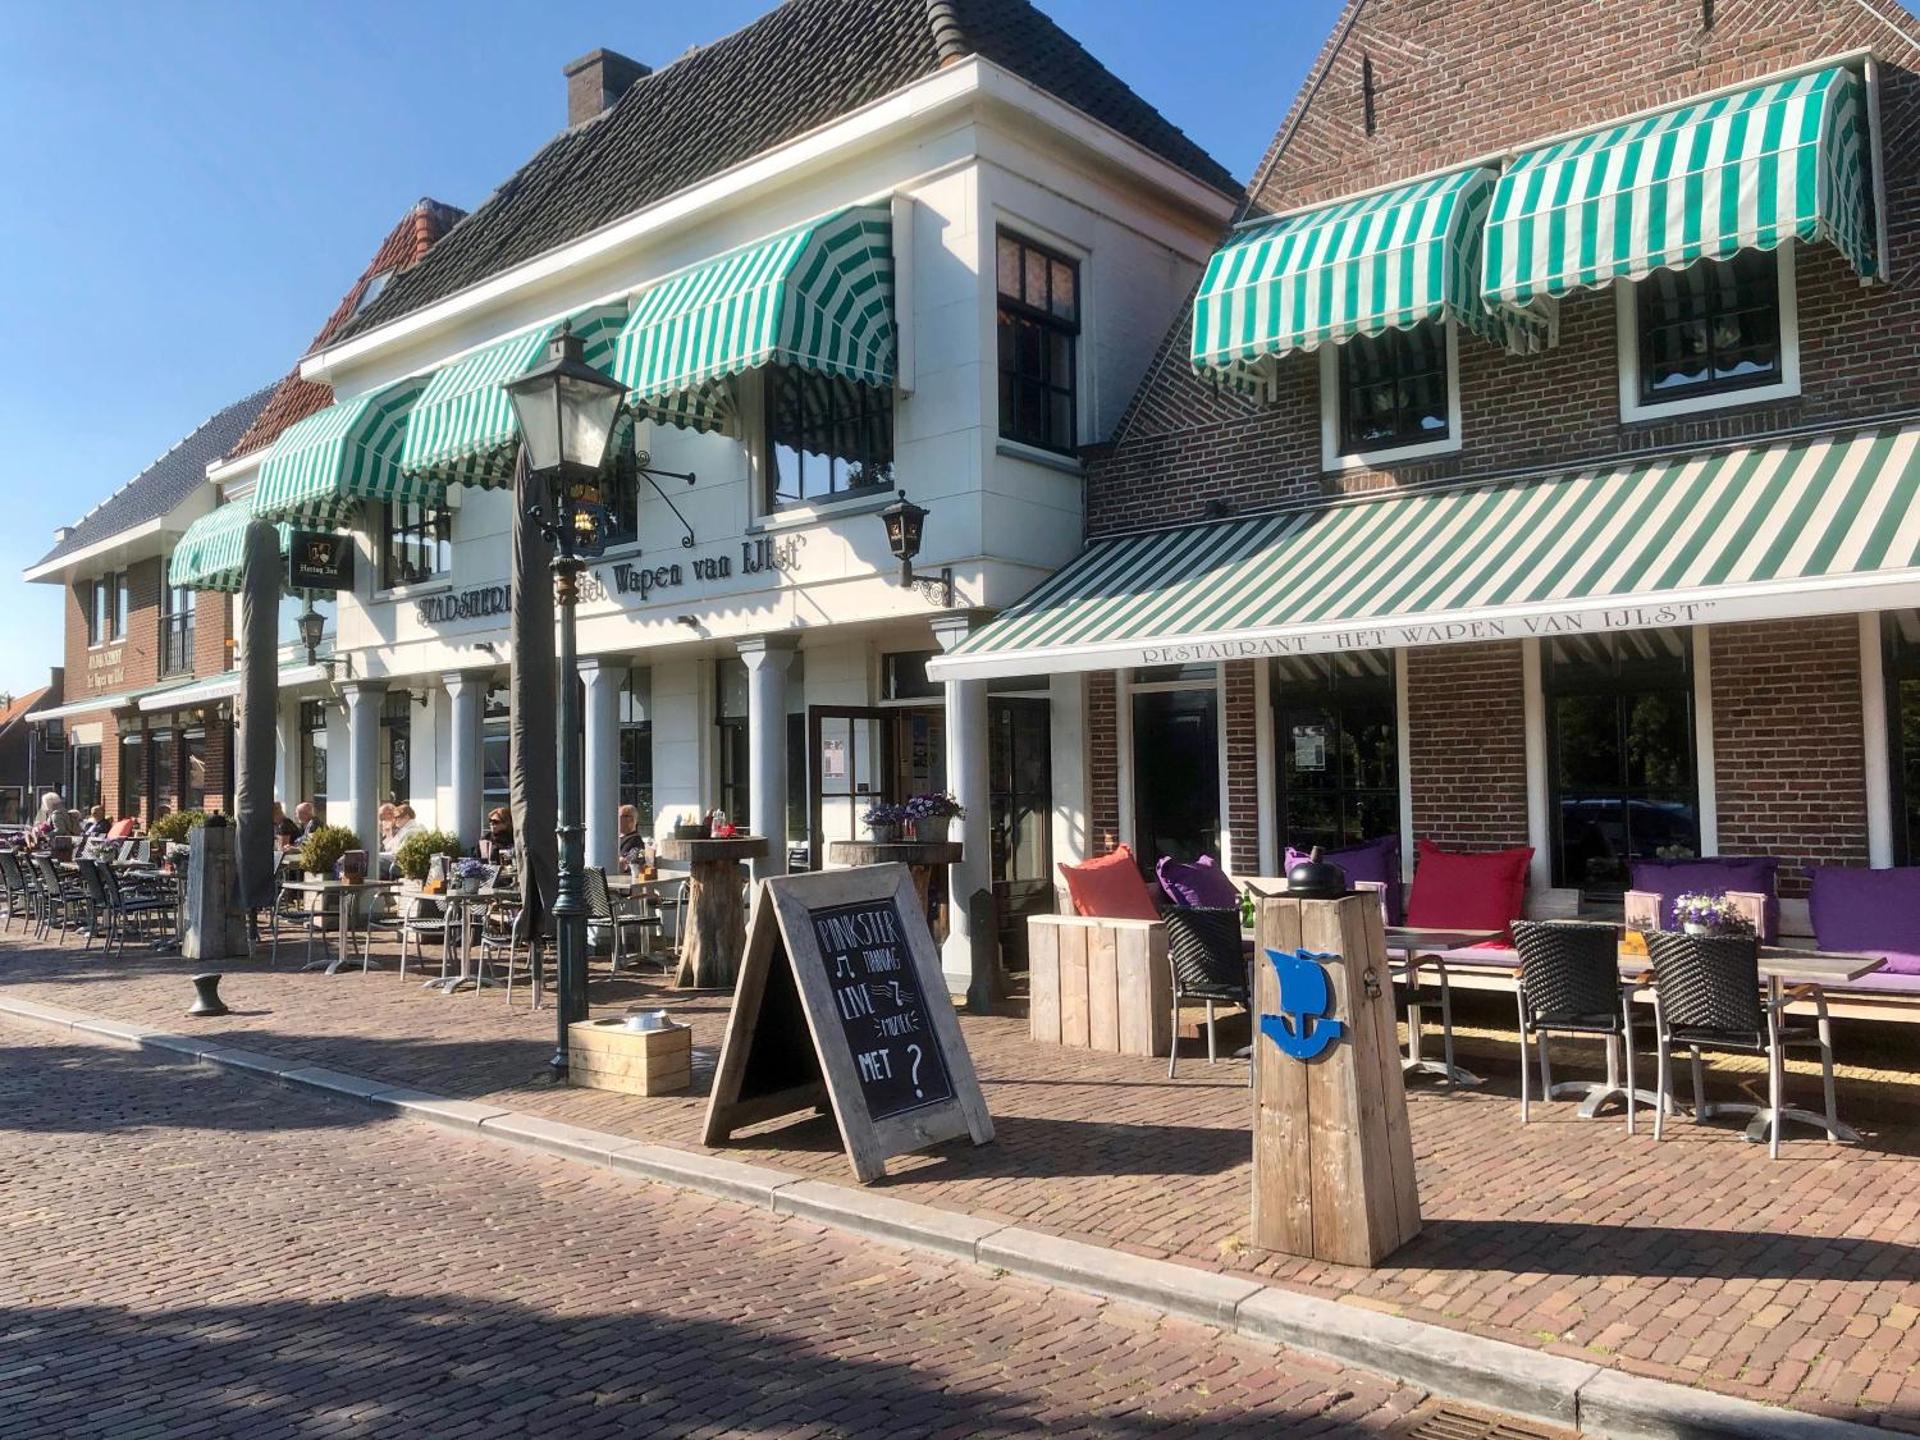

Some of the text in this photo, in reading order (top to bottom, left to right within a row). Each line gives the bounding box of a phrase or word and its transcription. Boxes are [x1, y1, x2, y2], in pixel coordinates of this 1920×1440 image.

[325, 566, 338, 576] Jan
[612, 562, 683, 601] Wapen
[691, 554, 732, 581] van
[1142, 636, 1307, 664] RESTAURANT
[1399, 619, 1507, 644] WAPEN
[1523, 613, 1583, 634] VAN
[817, 910, 901, 953] PINKSTER
[837, 982, 876, 1020] LIVE
[880, 1012, 914, 1038] MUZIEK
[857, 1043, 924, 1099] MET ?
